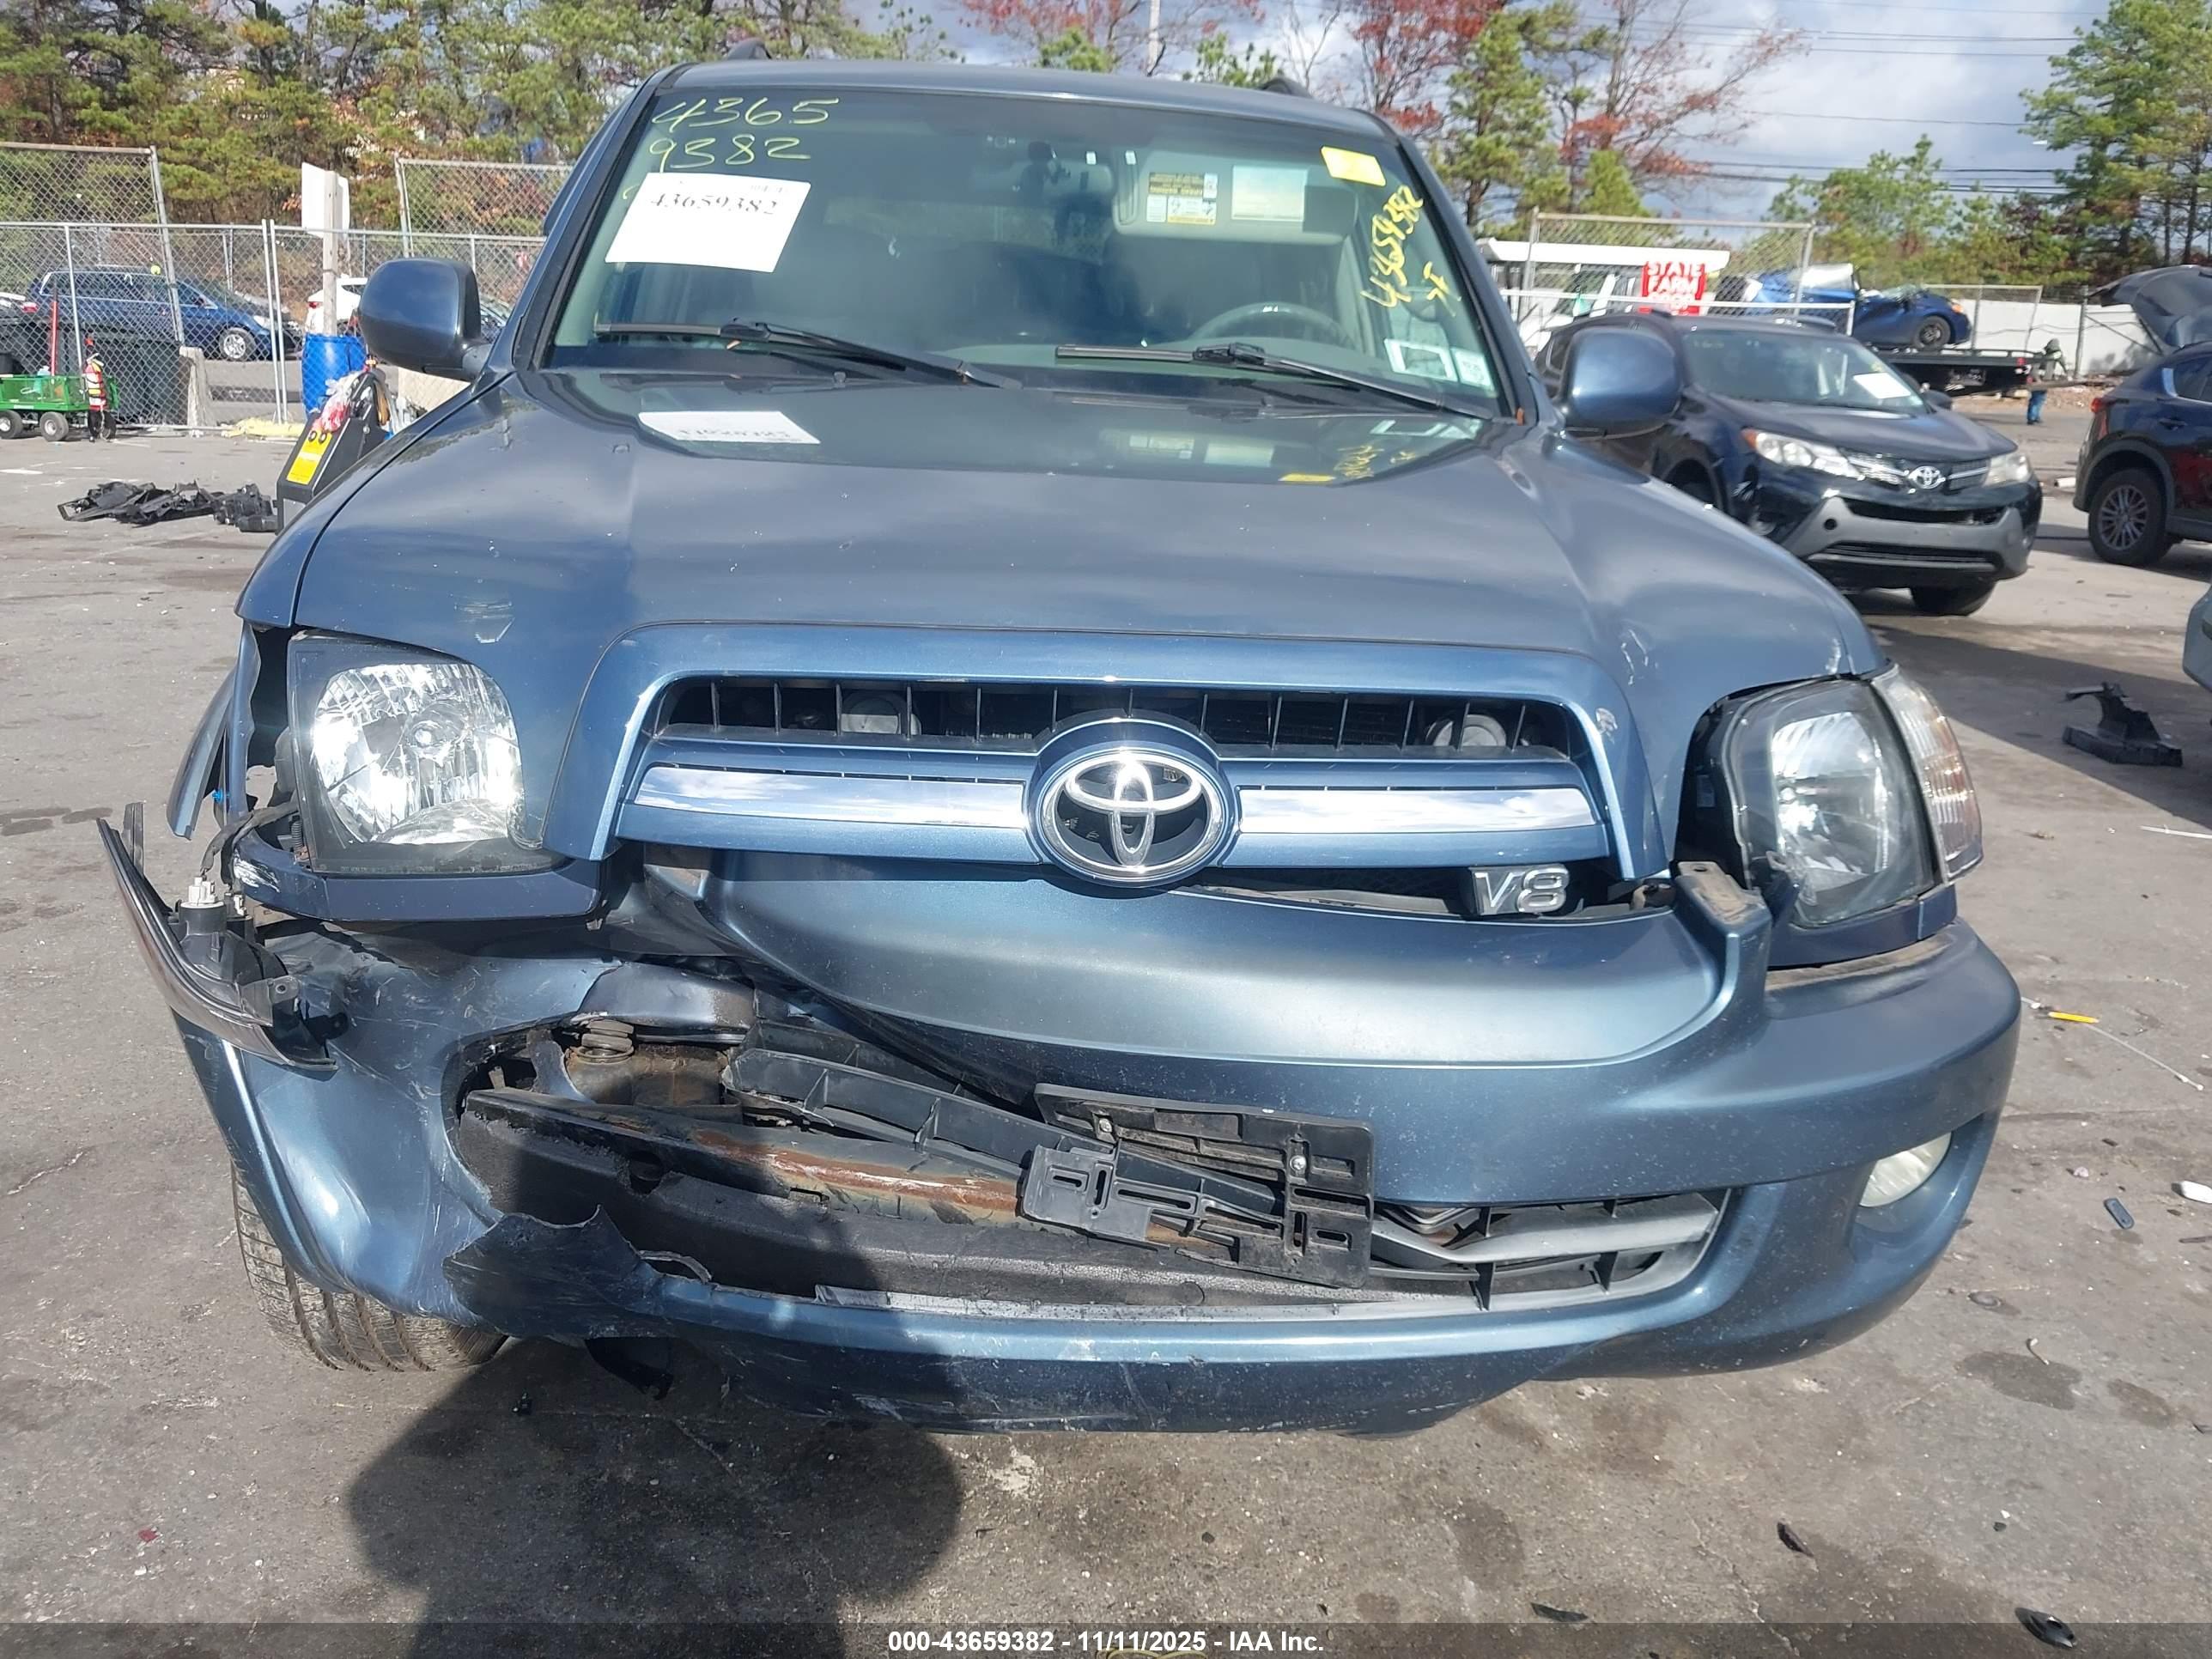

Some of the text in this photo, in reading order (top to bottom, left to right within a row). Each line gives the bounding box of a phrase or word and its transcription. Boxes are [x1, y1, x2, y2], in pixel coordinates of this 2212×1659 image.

[651, 96, 840, 133] 4365
[648, 133, 811, 173] 9382
[651, 192, 778, 216] 43659382
[1471, 864, 1570, 915] V8
